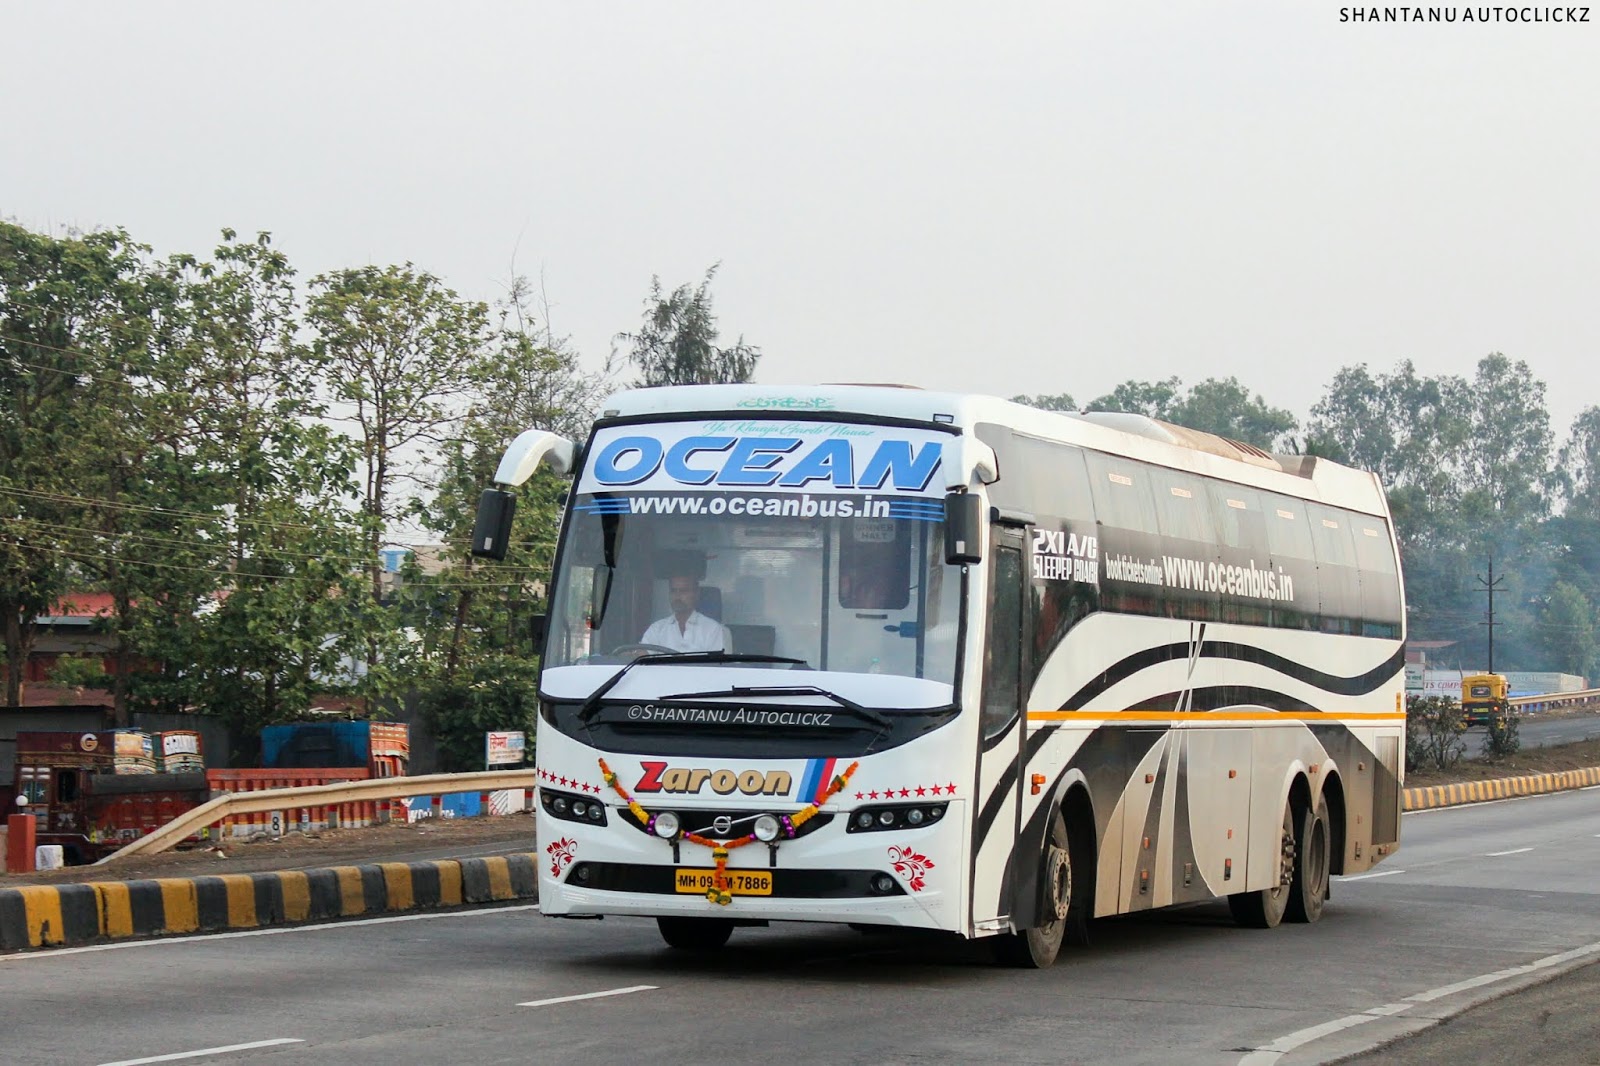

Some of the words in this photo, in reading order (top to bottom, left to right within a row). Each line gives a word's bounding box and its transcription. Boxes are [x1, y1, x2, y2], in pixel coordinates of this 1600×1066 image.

[593, 436, 943, 492] OCEAN
[628, 494, 891, 518] www.oceanbus.in
[1067, 533, 1097, 558] A/C
[1105, 551, 1123, 580] book
[1122, 554, 1145, 584] tickets
[1162, 555, 1294, 602] www.oceanbus.in
[80, 733, 98, 752] G
[634, 761, 793, 797] Zaroon
[737, 876, 769, 890] 7886
